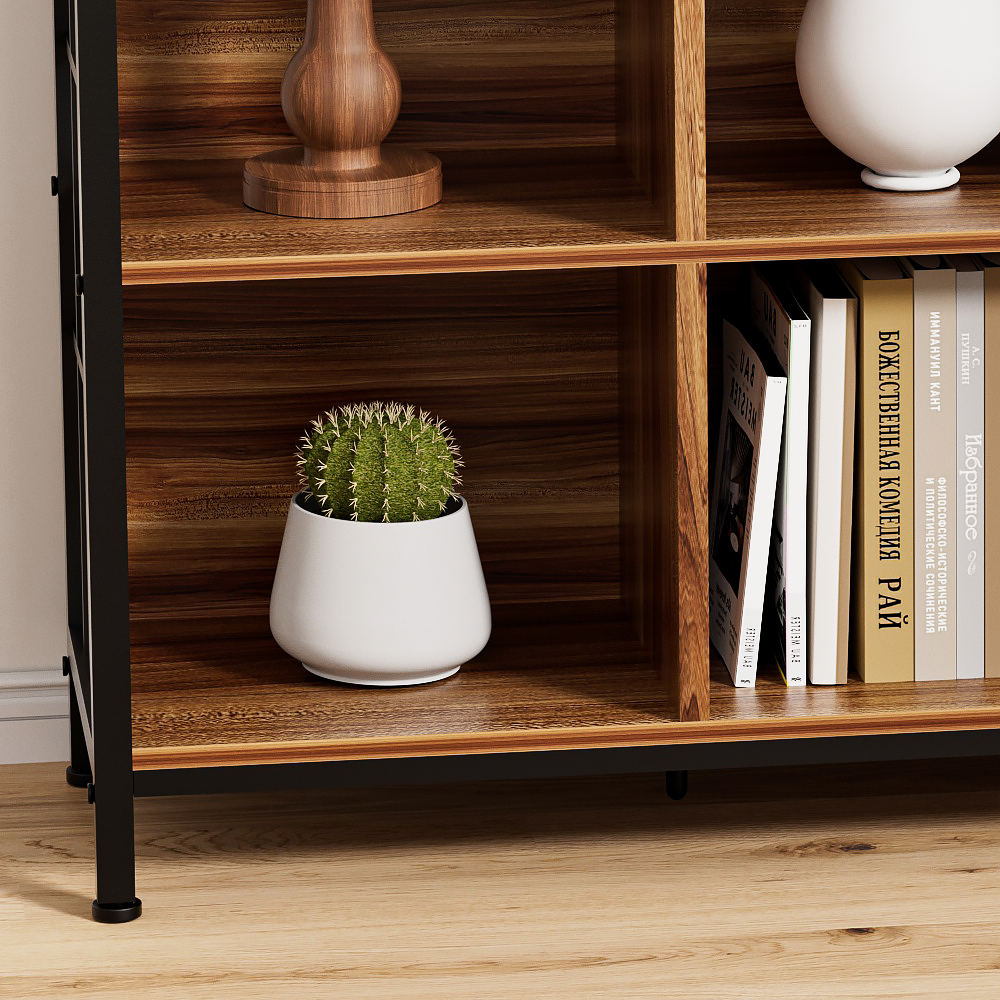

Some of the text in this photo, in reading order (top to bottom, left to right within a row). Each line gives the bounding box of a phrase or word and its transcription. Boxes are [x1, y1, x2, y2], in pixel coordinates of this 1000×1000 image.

[927, 310, 941, 411] ИММАНУИЛ КАНТ
[960, 332, 971, 385] ПУШКИН
[876, 330, 908, 629] БОЖЕСТВЕННАЯ КОМЕДИЯ РАЙ
[959, 433, 983, 540] Избранное
[924, 477, 936, 634] И ПОЛИТИЧЕСКИЕ СОЧИНЕНИЯ
[936, 477, 948, 633] ФИЛОСОФСКО-ИСТОРИЧЕСКИЕ
